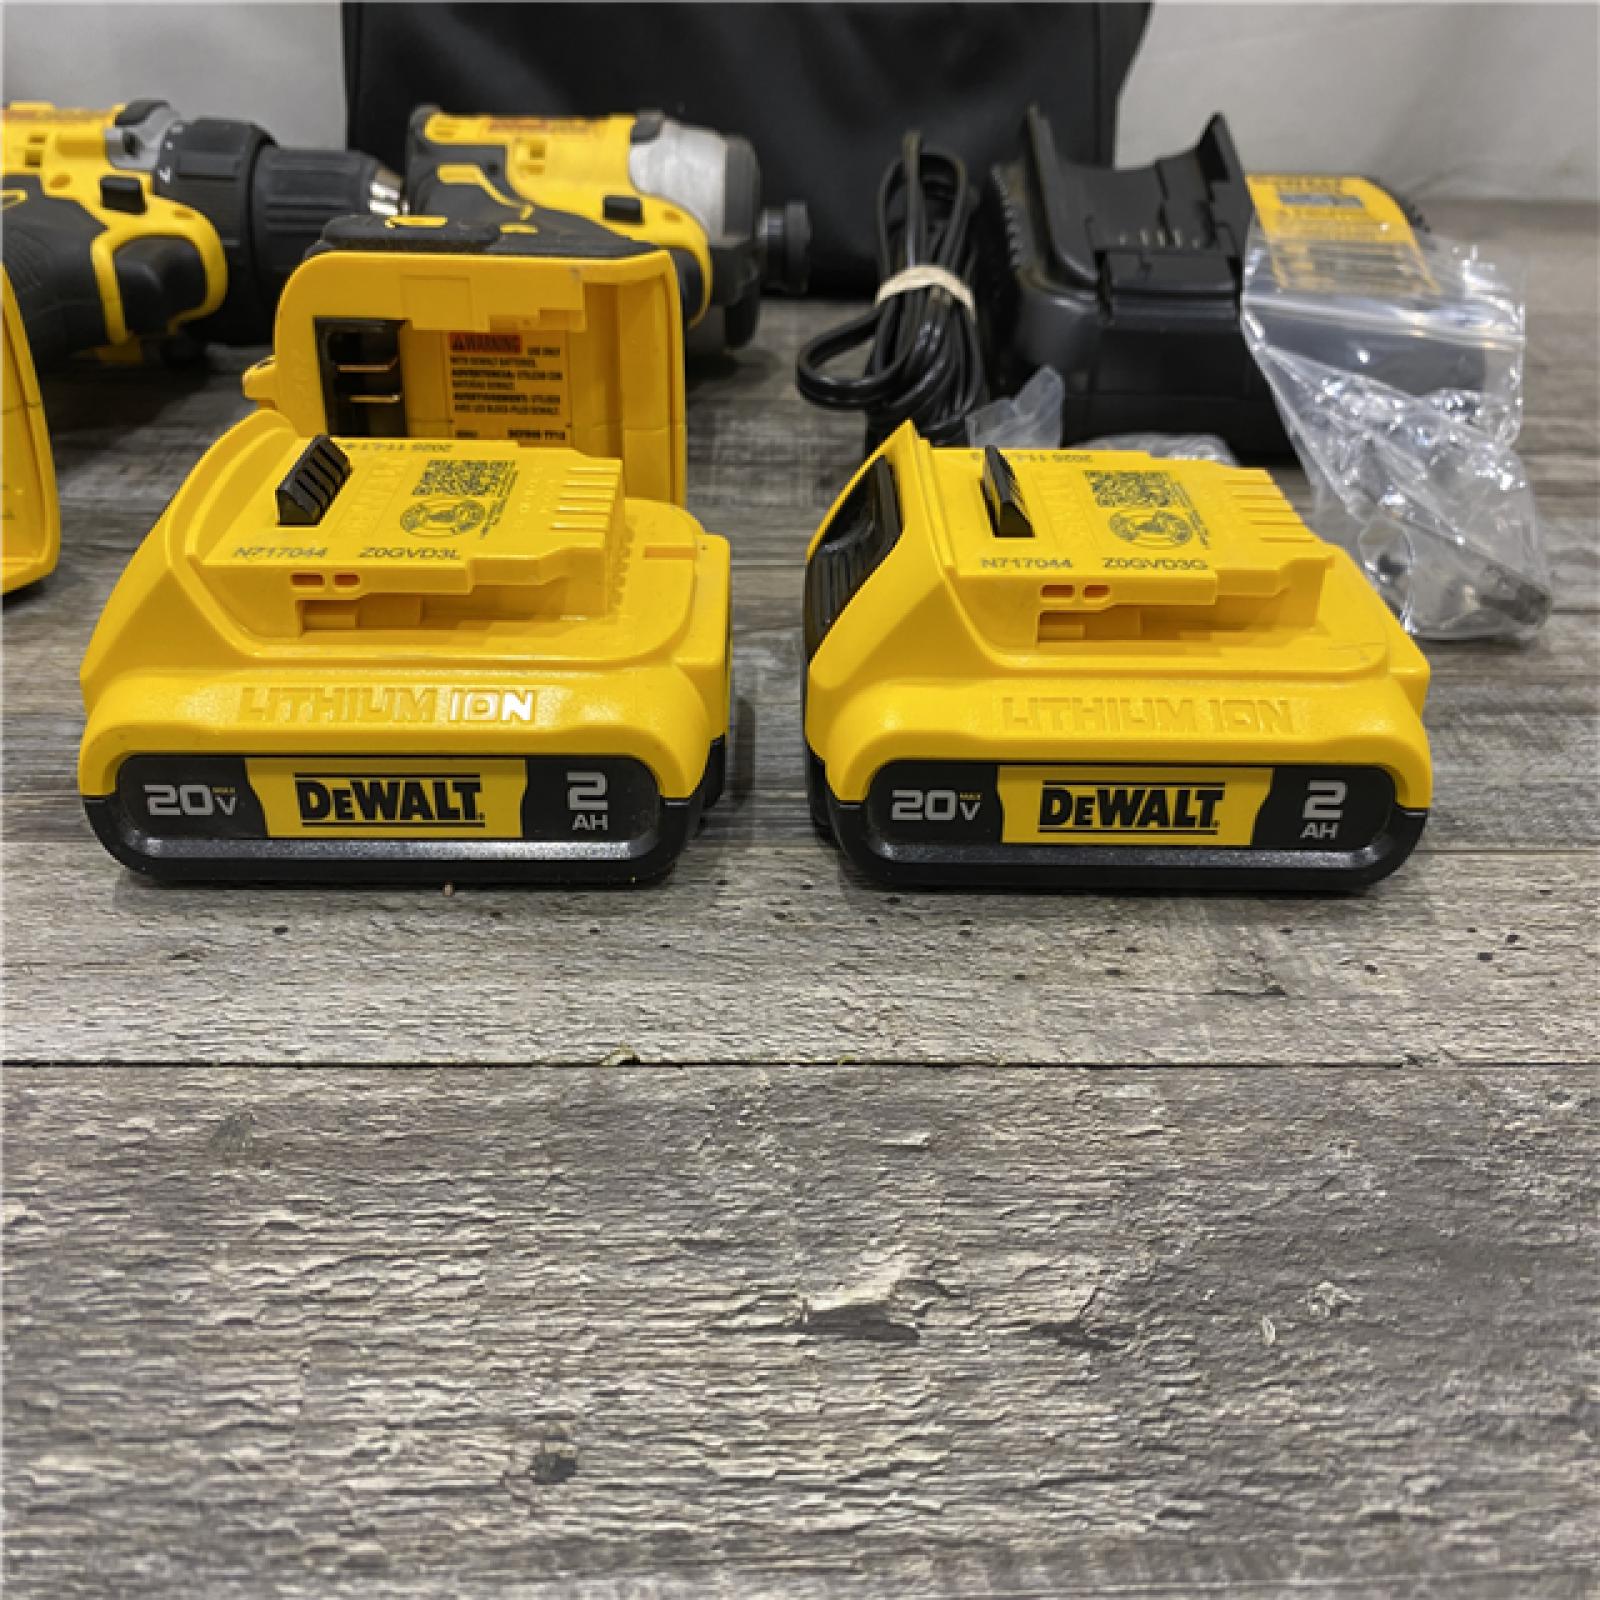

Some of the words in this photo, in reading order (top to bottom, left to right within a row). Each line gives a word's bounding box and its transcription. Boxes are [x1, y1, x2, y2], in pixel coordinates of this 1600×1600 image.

[239, 686, 437, 723] LITHIUM
[448, 687, 537, 723] ION
[1001, 696, 1201, 733] LITHIUM
[1207, 697, 1297, 734] ION
[566, 771, 608, 811] 2
[1303, 779, 1347, 821] 2
[571, 813, 608, 831] AH
[1300, 821, 1338, 839] AH
